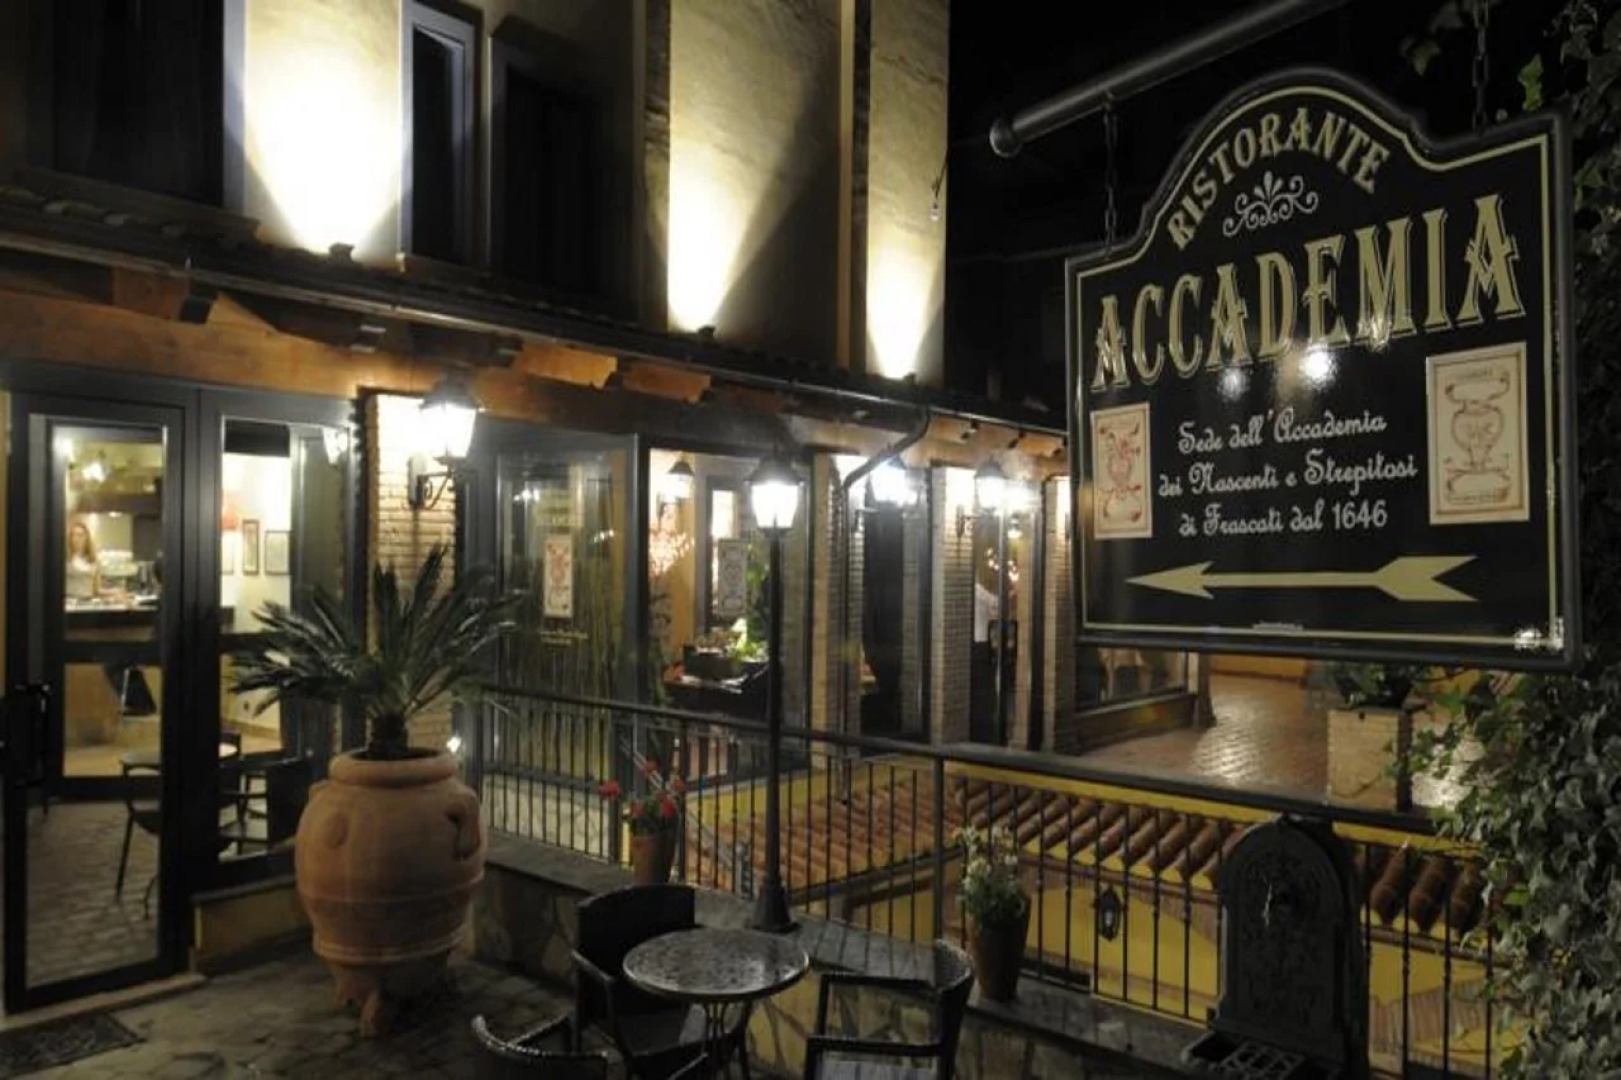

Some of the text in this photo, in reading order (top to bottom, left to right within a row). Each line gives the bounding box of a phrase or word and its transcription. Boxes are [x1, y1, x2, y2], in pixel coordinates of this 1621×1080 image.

[1167, 107, 1391, 250] RISTORANTE
[1091, 194, 1526, 392] ACCADEMIA
[1178, 420, 1222, 455] Sede
[1158, 448, 1418, 497] dei Nascenti e Strepitosi
[1179, 498, 1388, 537] di Frascati dal 1646
